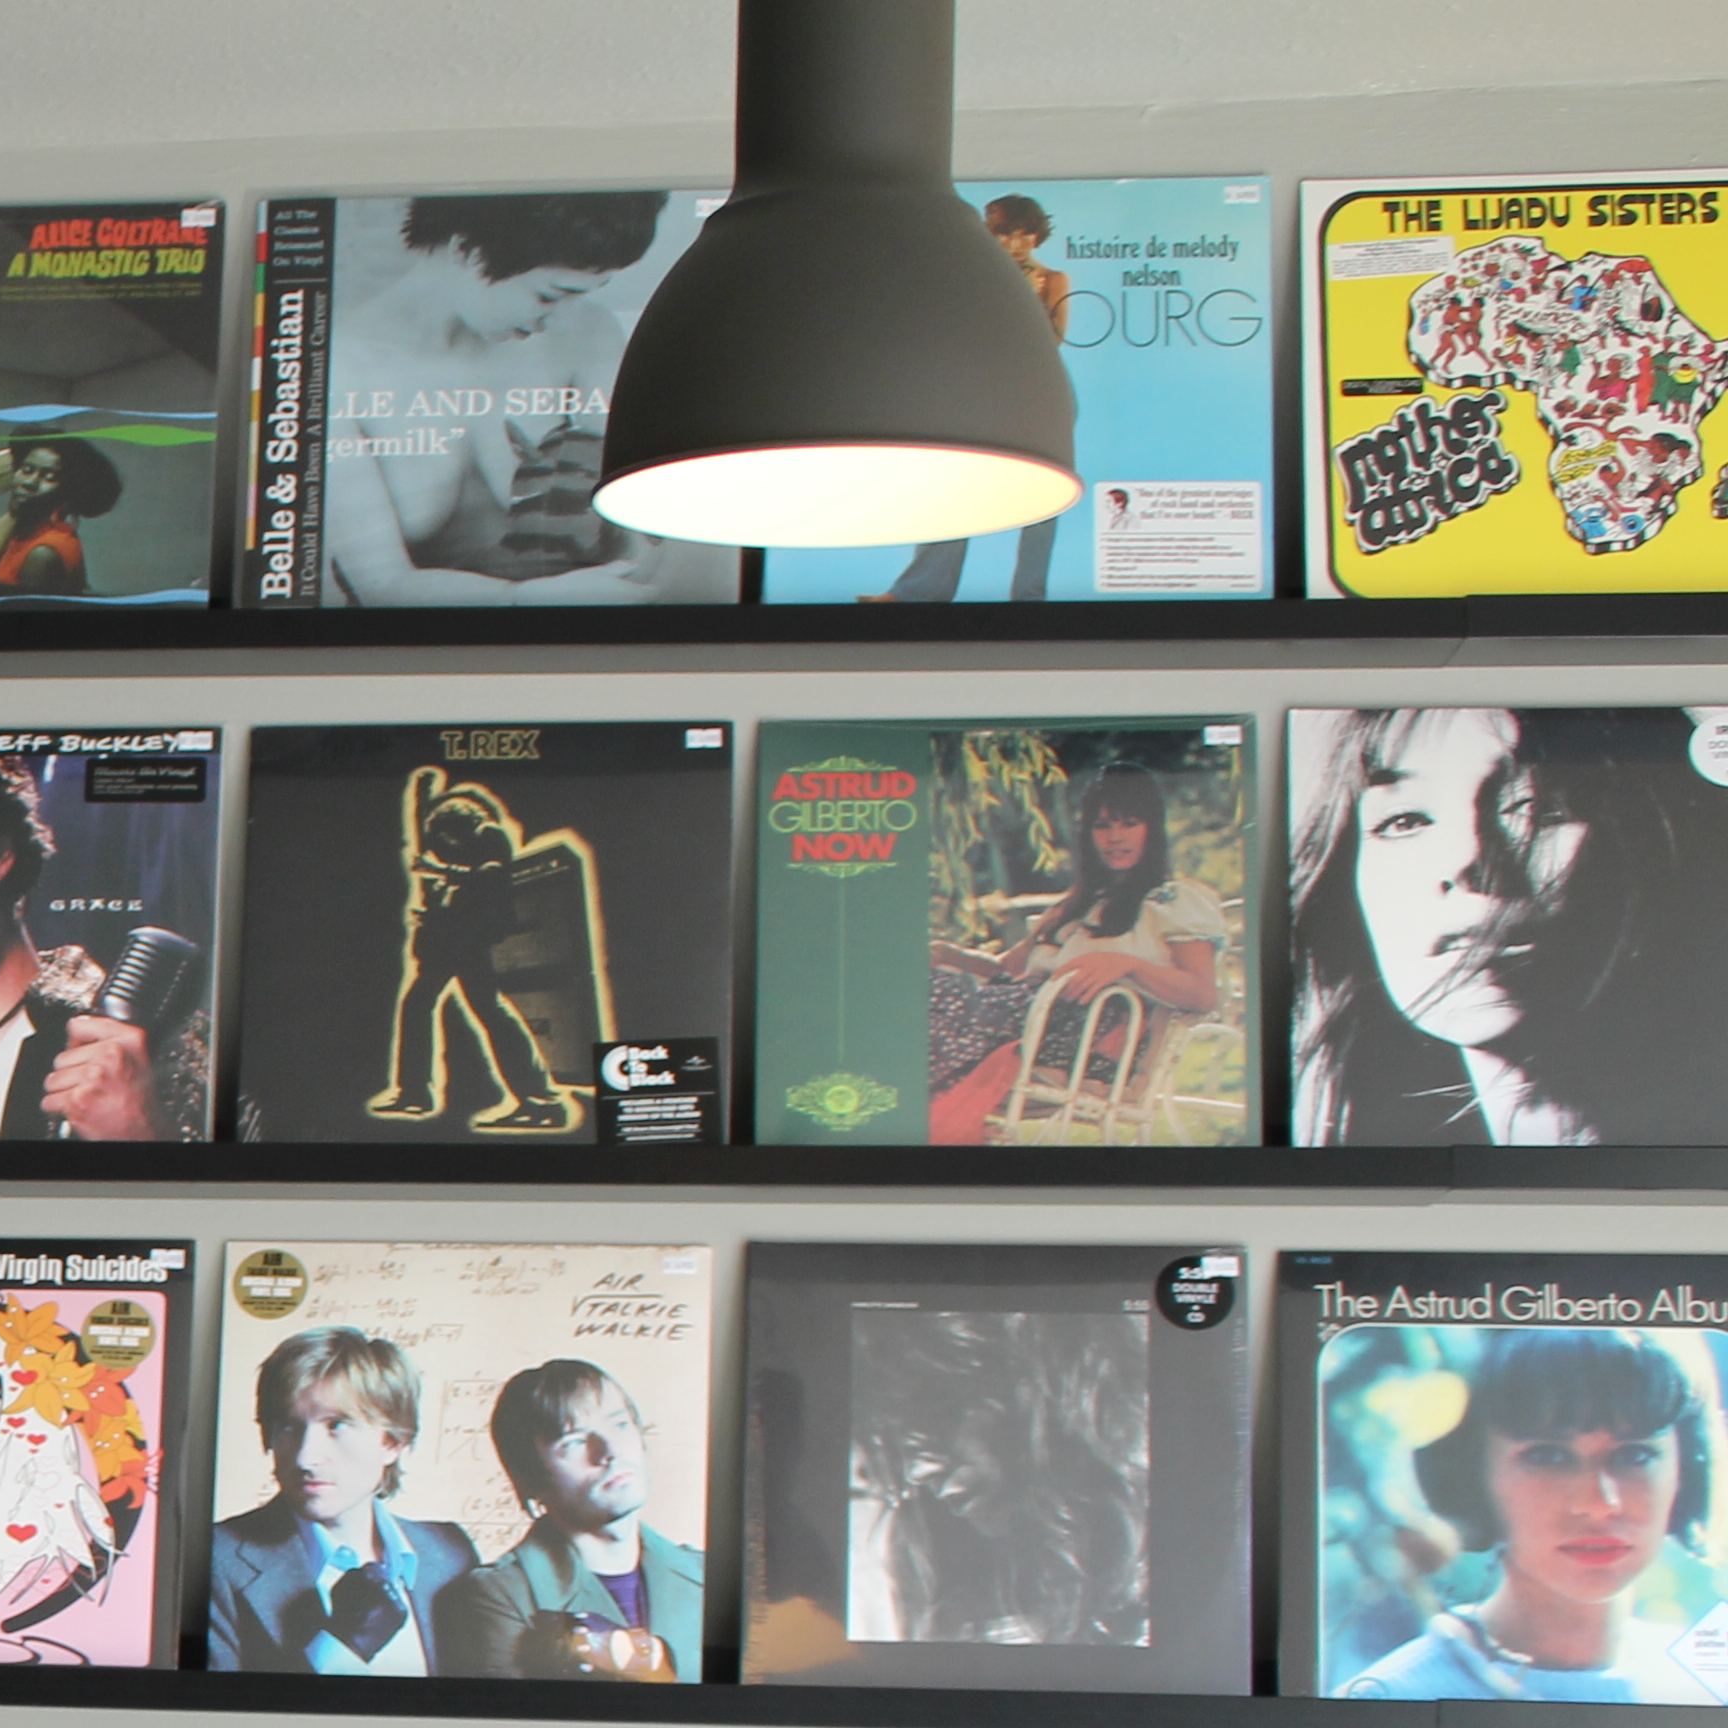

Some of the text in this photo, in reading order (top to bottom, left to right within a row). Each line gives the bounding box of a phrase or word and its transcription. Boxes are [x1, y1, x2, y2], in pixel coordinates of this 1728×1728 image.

[1382, 191, 1720, 233] THE LIJADU SISTERS
[29, 219, 94, 249] ALICE
[1066, 233, 1238, 262] histoire de melody
[7, 249, 206, 278] A MONASTIC TRIO
[1122, 264, 1181, 287] nelson
[1050, 288, 1262, 347] OURG
[406, 390, 493, 416] AND
[505, 388, 611, 415] SEBA
[262, 289, 305, 600] Belle & Sebastian
[300, 291, 327, 597] It Could Have Been A Brilliant Career
[58, 733, 181, 753] BUCKLEY
[440, 730, 541, 760] T. REX
[771, 771, 916, 800] ASTRUD
[768, 801, 917, 833] GILBERTO
[792, 833, 898, 862] NOW
[49, 898, 144, 912] GRACE
[628, 1046, 670, 1061] Back
[629, 1070, 677, 1087] Black
[66, 1254, 169, 1284] Suicides
[591, 1272, 645, 1291] AIR
[1171, 1283, 1218, 1294] DOUBLE
[1174, 1294, 1216, 1304] VINYLE
[1314, 1281, 1378, 1319] The
[1384, 1283, 1492, 1320] Astrud
[1500, 1284, 1642, 1322] Gilberto
[585, 1302, 687, 1321] TALKIE
[1186, 1312, 1206, 1323] CD
[573, 1323, 694, 1340] WALKIE
